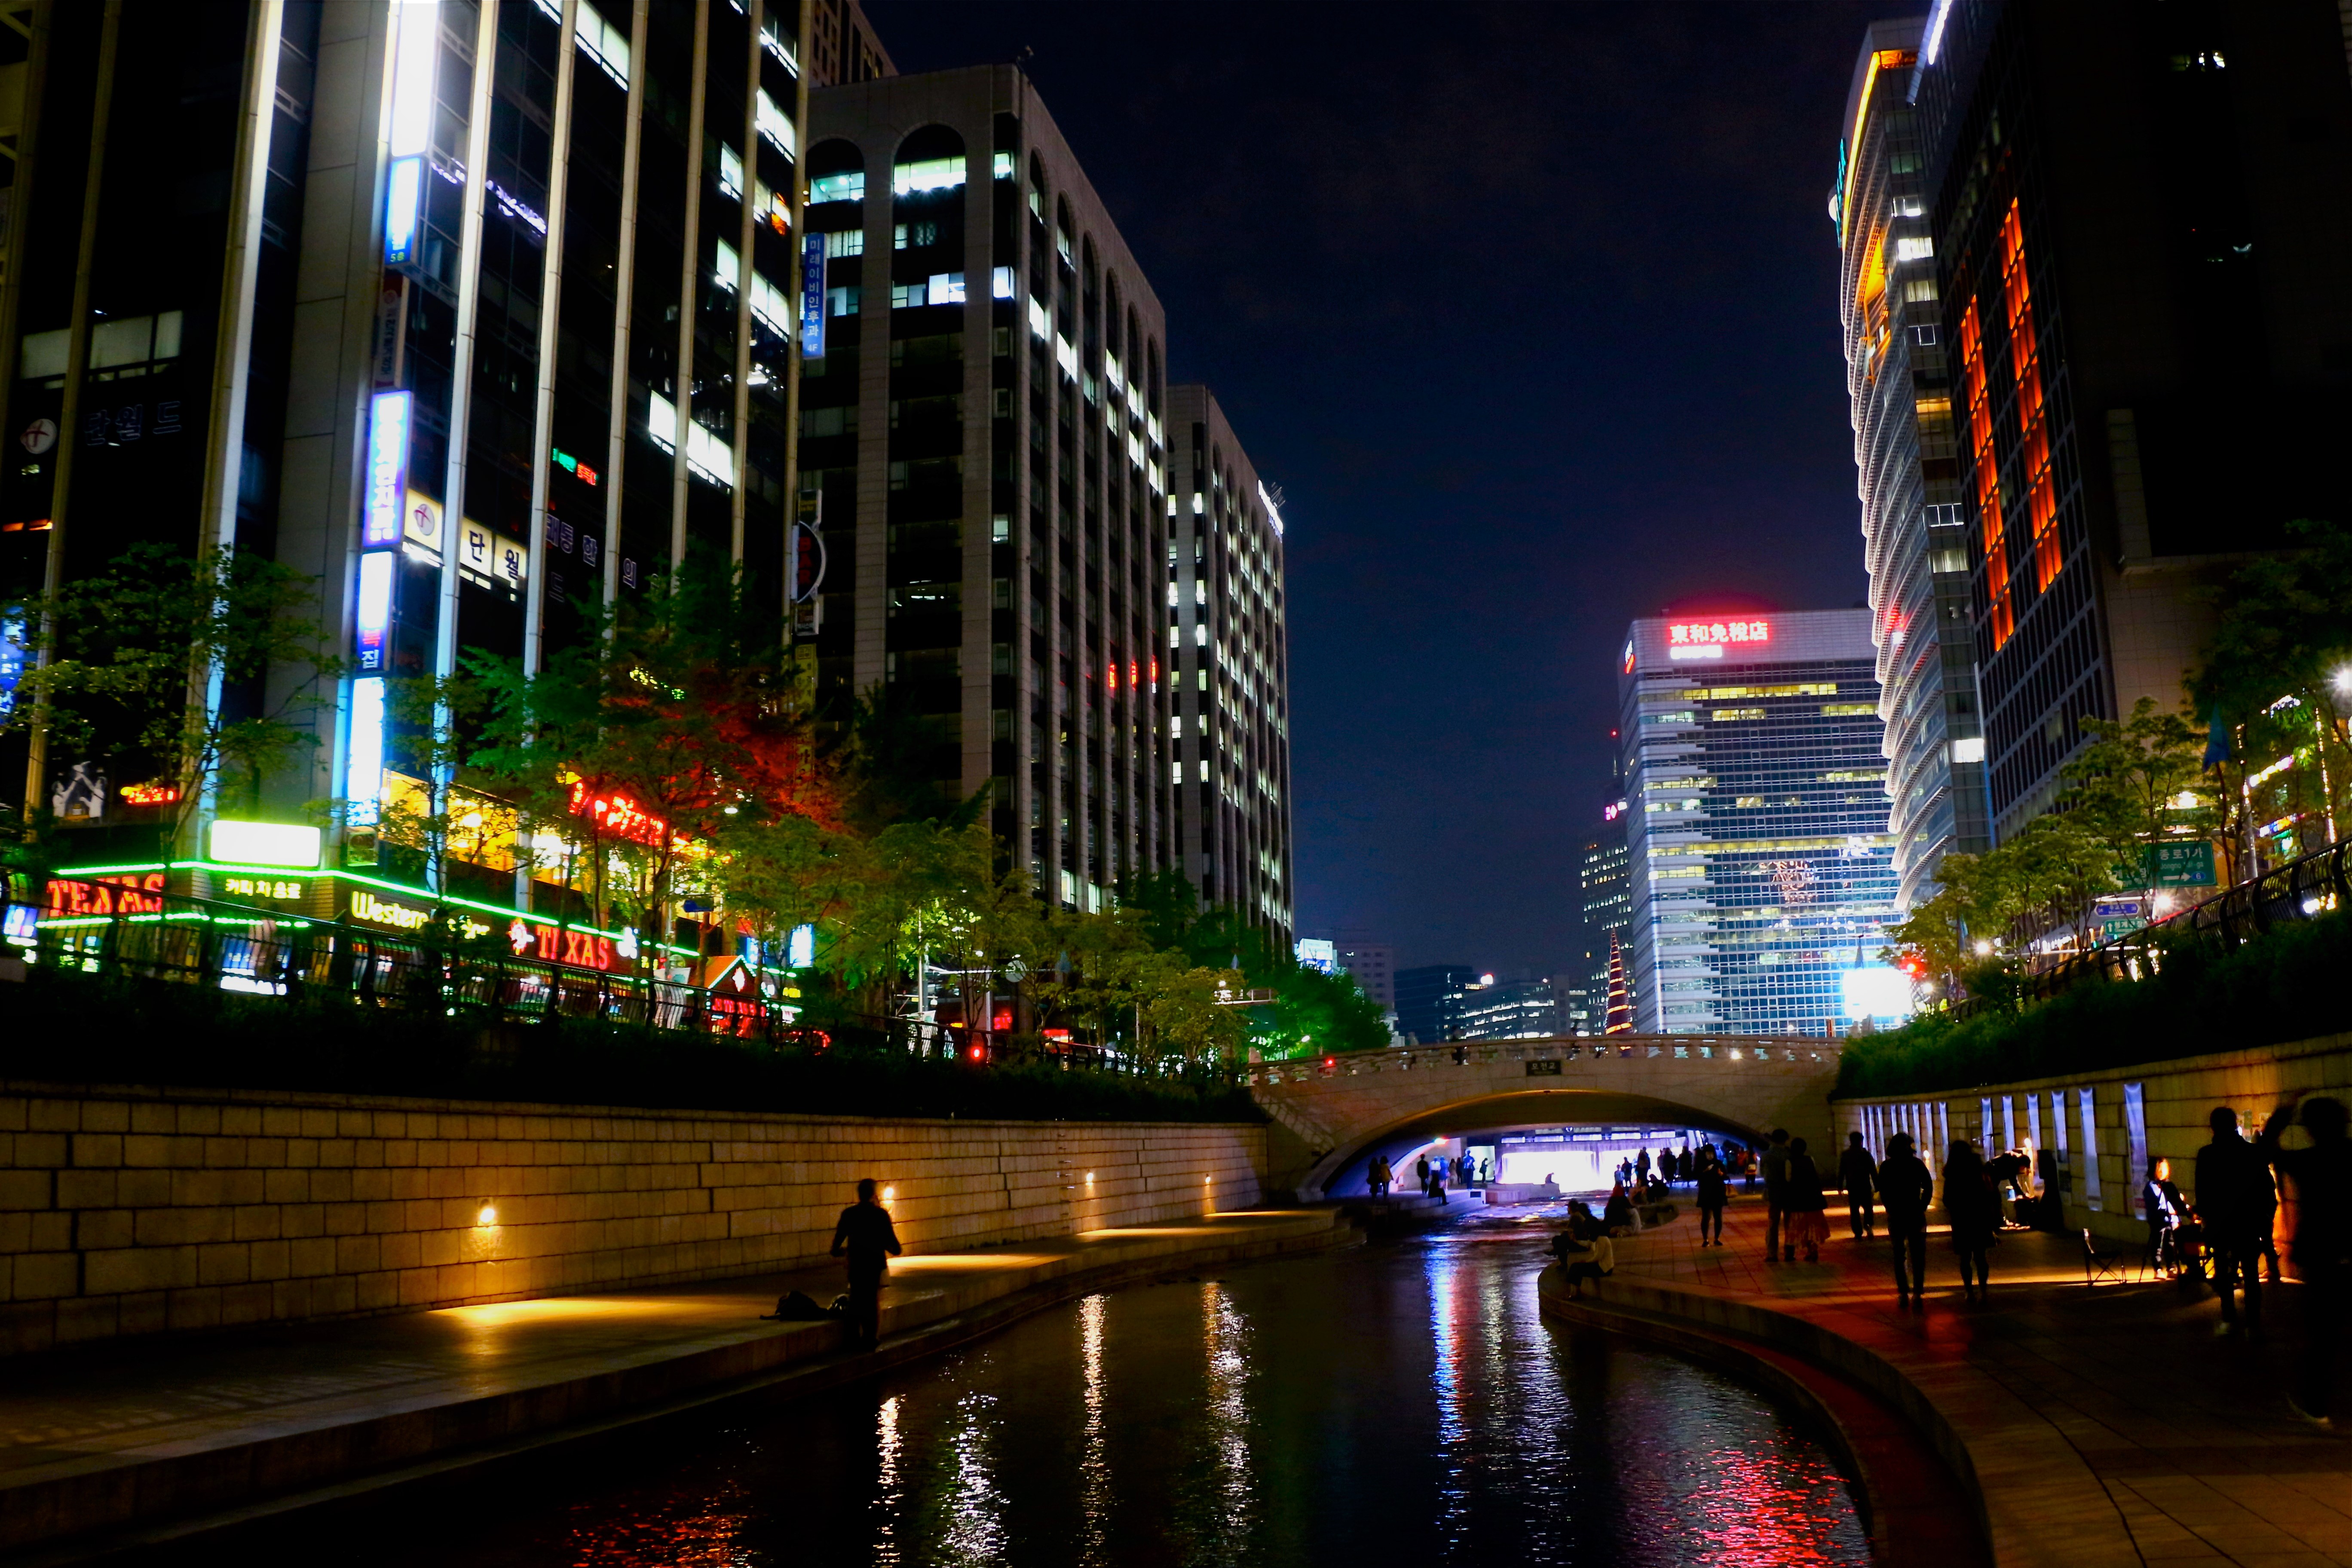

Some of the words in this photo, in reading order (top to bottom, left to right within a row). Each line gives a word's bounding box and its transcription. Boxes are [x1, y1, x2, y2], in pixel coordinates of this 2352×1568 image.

[807, 239, 820, 337] 미래이비인후과
[807, 343, 818, 352] 4F
[83, 400, 183, 447] 단월드
[797, 536, 812, 585] BAR
[2159, 847, 2203, 860] 종로1가
[47, 873, 165, 917] TEXAS
[225, 879, 254, 897] 커피
[256, 880, 272, 897] 차
[273, 881, 301, 899] 음료
[351, 891, 429, 929] Western
